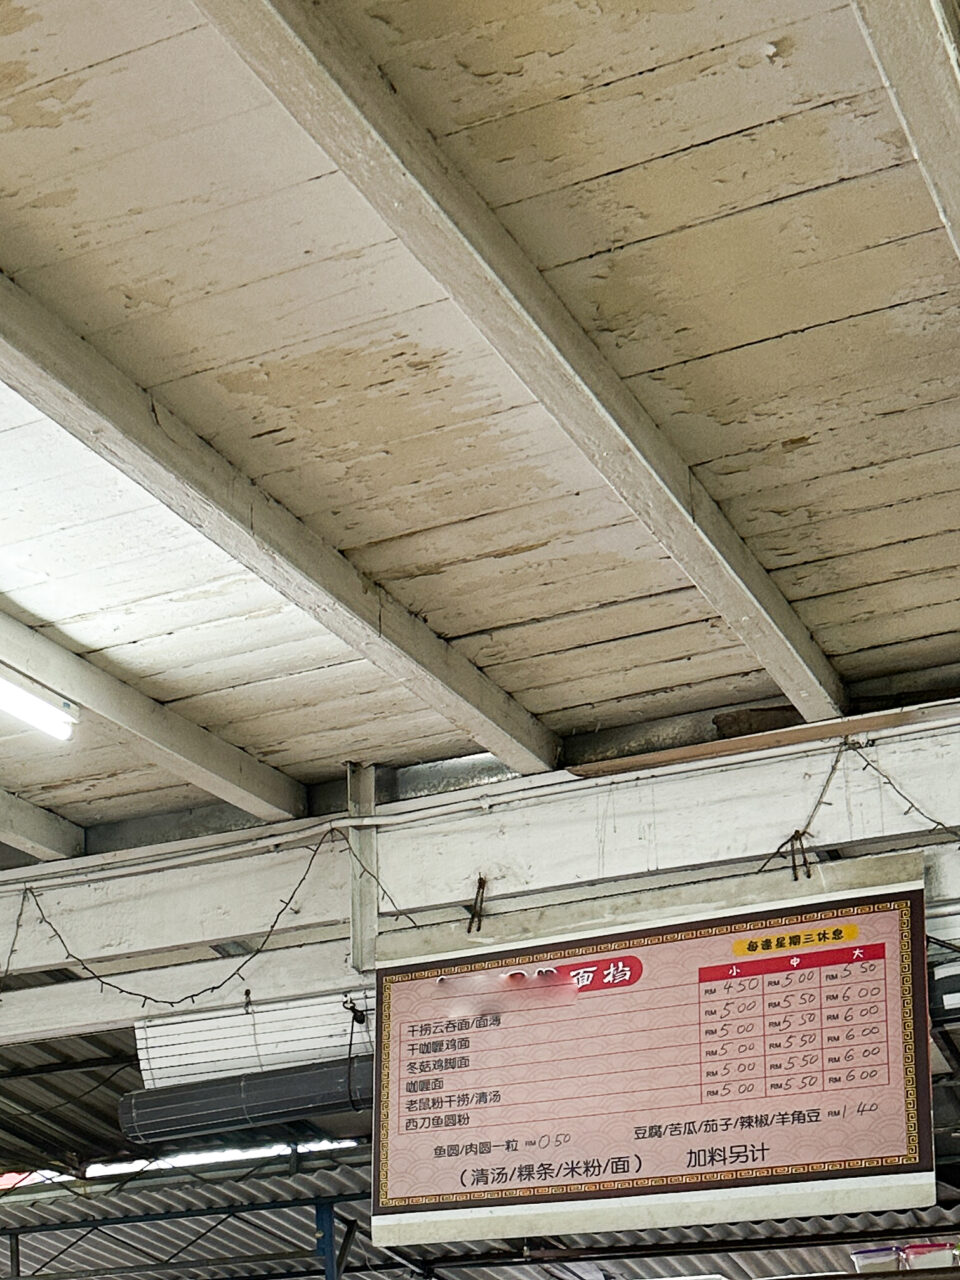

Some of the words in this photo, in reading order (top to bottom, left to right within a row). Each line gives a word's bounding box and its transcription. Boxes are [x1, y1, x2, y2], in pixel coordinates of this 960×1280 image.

[728, 965, 740, 976] 小
[790, 956, 800, 967] 中
[853, 948, 864, 959] 大
[405, 1077, 444, 1093] 咖喱面
[405, 1113, 470, 1131] 西刀鱼圆粉
[686, 1143, 770, 1169] 加料另计
